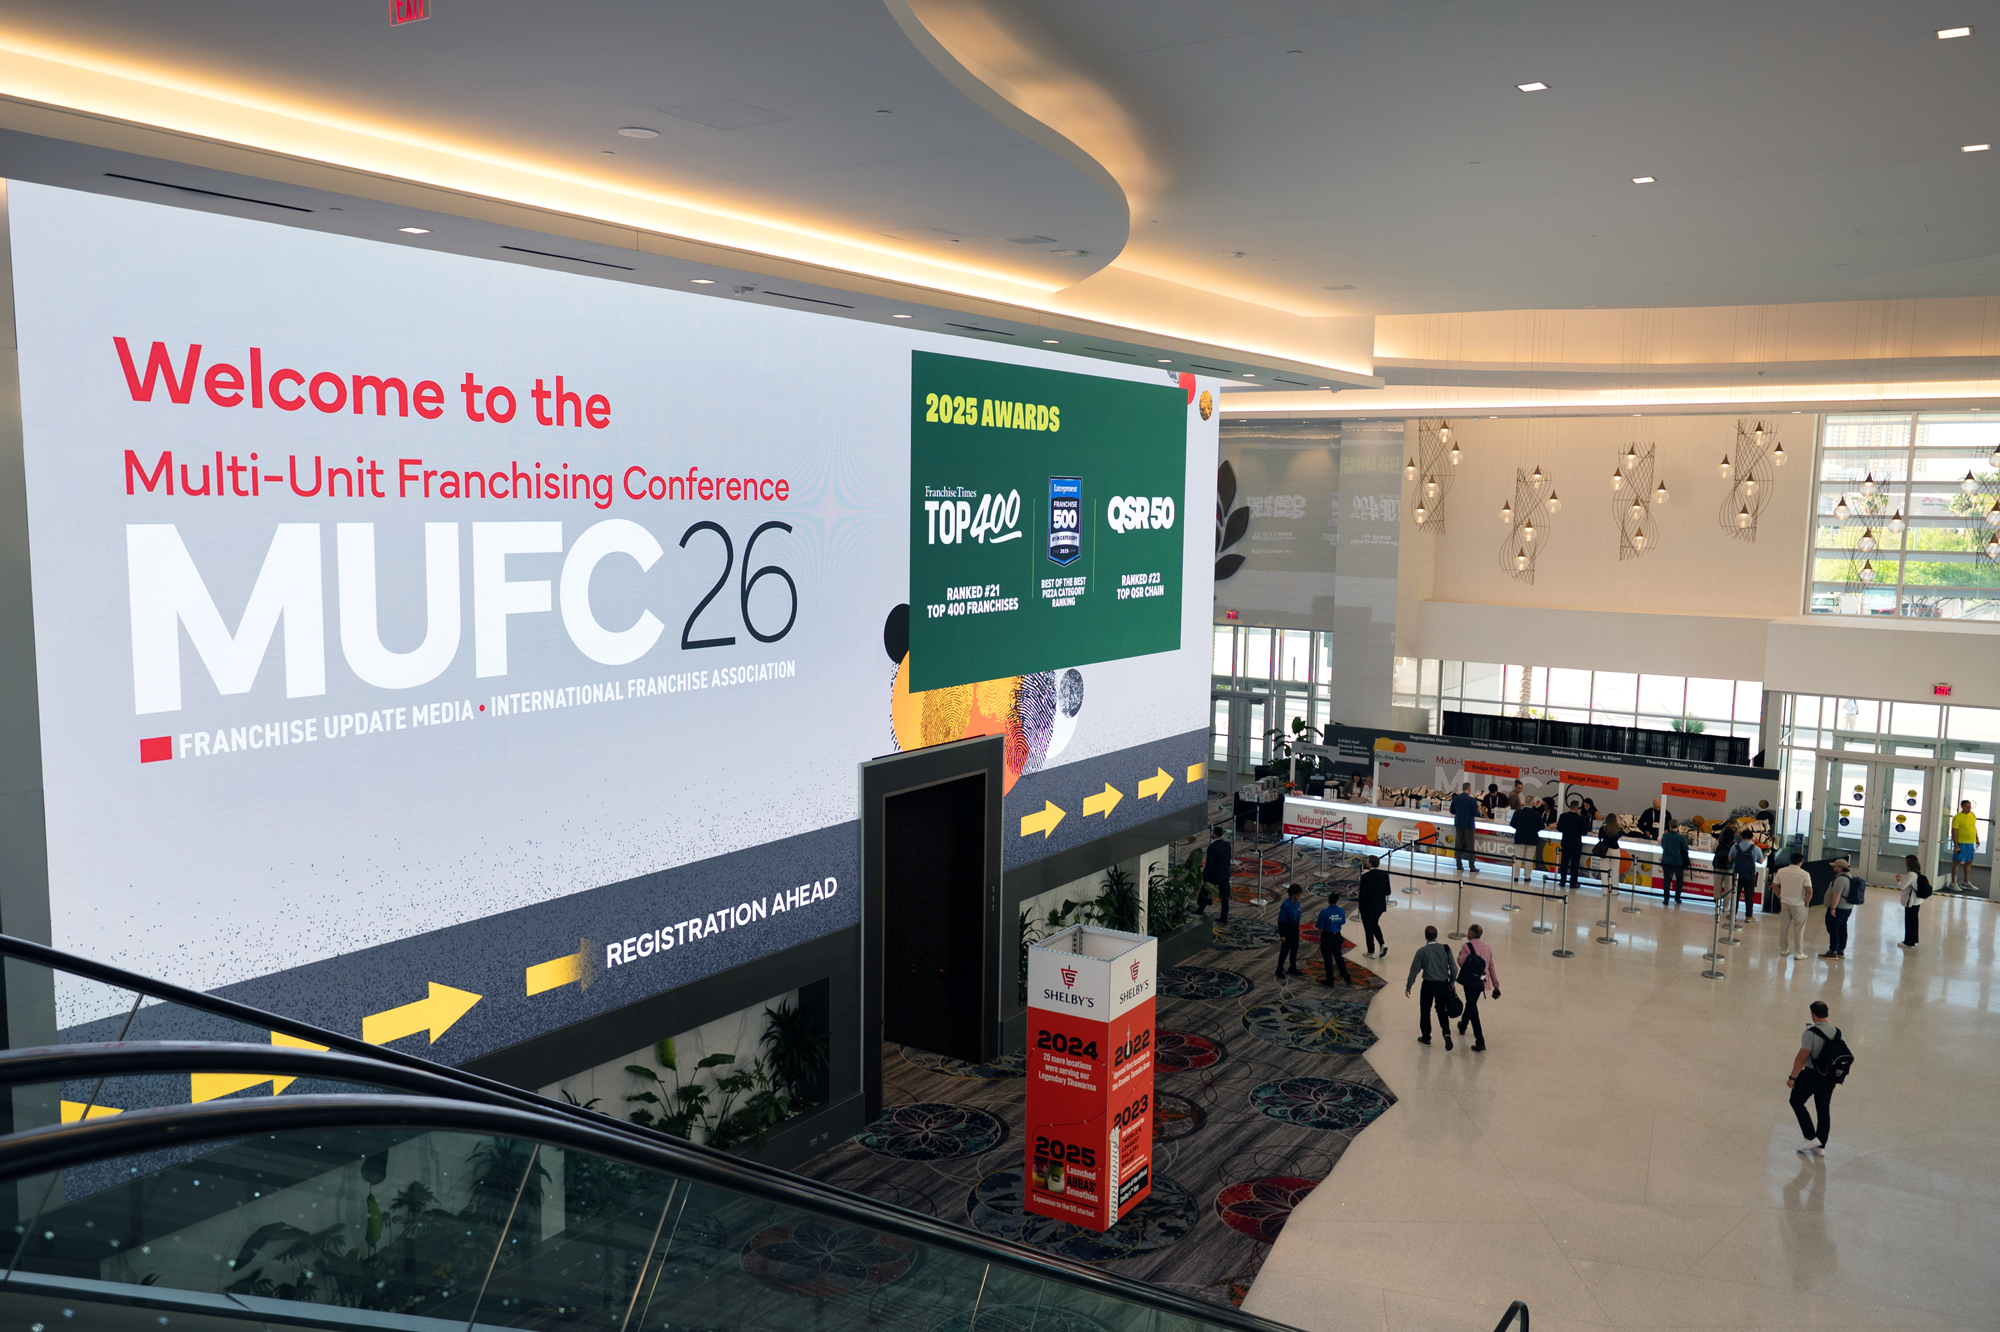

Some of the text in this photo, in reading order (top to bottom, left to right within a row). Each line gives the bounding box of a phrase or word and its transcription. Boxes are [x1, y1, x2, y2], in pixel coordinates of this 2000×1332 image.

[113, 336, 611, 429] Welcome to the
[926, 393, 1060, 432] 2025 AWARDS
[125, 449, 789, 510] Multi-Unit Franchising Conference
[924, 486, 977, 498] Franchise Times
[1053, 484, 1078, 494] Entrepreneur
[1053, 500, 1078, 508] FRANCHISE
[924, 489, 1020, 544] TOP 400
[1053, 509, 1078, 529] 500
[1041, 576, 1086, 588] BEST OF THE BEST
[1121, 572, 1161, 586] RANKED #23
[947, 584, 1000, 601] RANKED #21
[1042, 586, 1085, 598] PIZZA CATEGORY
[1117, 585, 1164, 600] TOP QSR CHAIN
[927, 597, 1019, 619] TOP 400 FRANCHISES
[1052, 597, 1076, 608] RANKING
[126, 518, 797, 715] MUFC 26
[1936, 686, 1950, 695] EXIT
[179, 660, 795, 758] FRANCHISE UPDATE MEDIA INTERNATIONAL FRANCHISE ASSOCIATION
[1410, 735, 1435, 743] Registration
[1301, 745, 1329, 754] Questions
[1551, 749, 1579, 758] Wednesday
[1375, 753, 1426, 764] On-Site Registration
[1646, 759, 1669, 767] Thursday
[1472, 764, 1489, 772] Badge
[1490, 766, 1511, 775] Pick-Up
[1568, 775, 1610, 786] Badge Pick-Up
[1671, 786, 1717, 797] Badge Pick-Up
[1297, 814, 1322, 826] National
[1474, 839, 1515, 856] MUFC
[607, 877, 838, 968] REGISTRATION AHEAD
[1044, 989, 1094, 1008] SHELBY'S
[1120, 979, 1149, 1005] SHELBY'S
[1037, 1030, 1098, 1060] 2024
[1114, 1029, 1150, 1068] 2022
[1043, 1052, 1092, 1071] 20 more locations
[1045, 1063, 1090, 1081] were serving our
[1038, 1070, 1097, 1092] Legendary Shawarma
[1113, 1094, 1148, 1130] 2023
[1035, 1136, 1096, 1168] 2025
[1121, 1135, 1139, 1152] LONGEST
[1121, 1144, 1139, 1160] FALAFEL
[1066, 1165, 1096, 1180] Launched
[1066, 1176, 1097, 1193] ABBAS'
[1066, 1186, 1098, 1202] Smoothies
[1033, 1194, 1056, 1207] Expansion
[1062, 1203, 1070, 1211] the
[1070, 1205, 1077, 1213] US
[1077, 1206, 1096, 1218] started.
